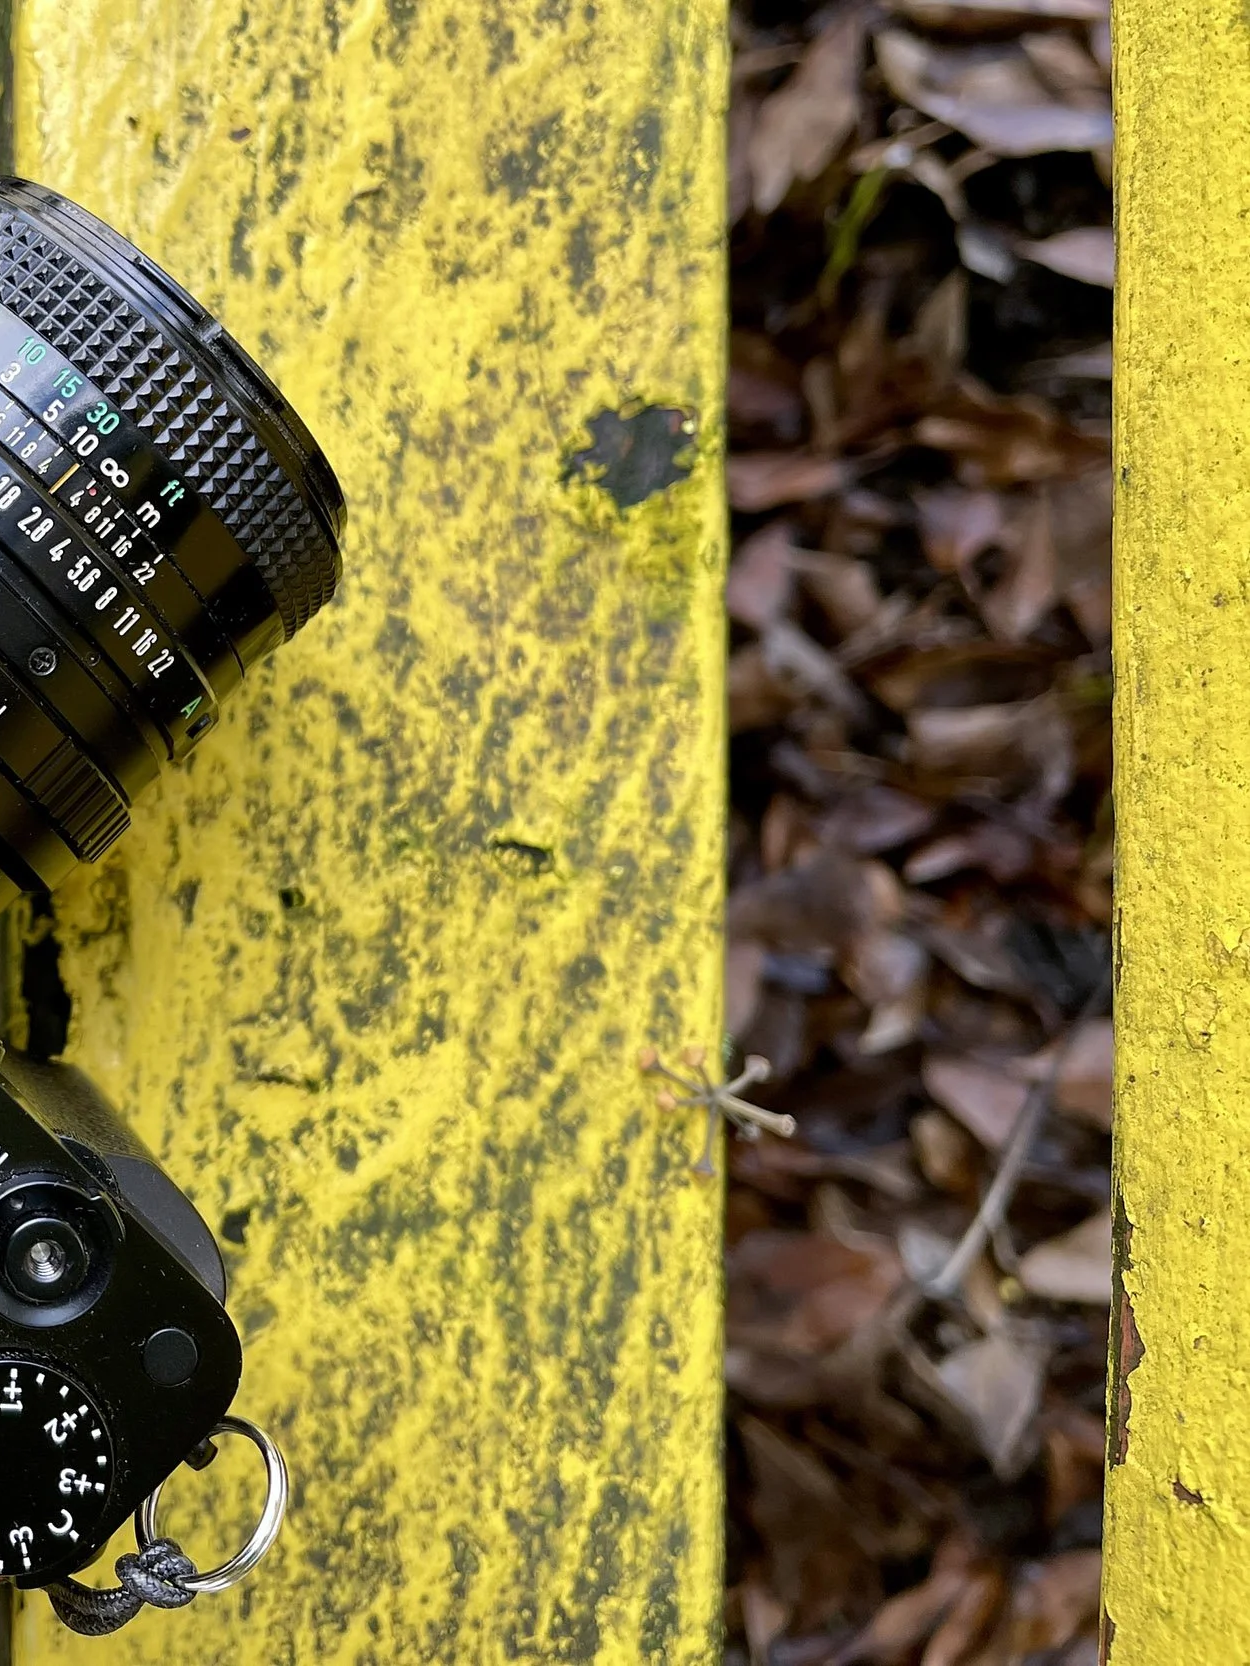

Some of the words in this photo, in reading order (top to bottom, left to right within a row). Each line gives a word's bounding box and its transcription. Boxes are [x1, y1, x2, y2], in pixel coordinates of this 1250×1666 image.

[0, 362, 22, 383] 3
[42, 400, 65, 423] 5
[69, 425, 99, 457] 10
[136, 501, 161, 528] m
[17, 335, 47, 366] 10
[52, 367, 83, 398] 15
[86, 401, 121, 435] 30
[159, 479, 185, 508] ft
[5, 426, 26, 448] 11
[20, 441, 38, 459] 8
[37, 457, 53, 475] 4
[69, 490, 85, 507] 4
[84, 506, 102, 524] 8
[94, 517, 116, 539] 11
[111, 535, 133, 558] 16
[133, 561, 156, 586] 22
[17, 506, 54, 542] 2.8
[49, 538, 72, 562] 4
[67, 555, 101, 592] 5.6
[94, 587, 118, 610] 8
[113, 606, 141, 636] 11
[131, 628, 158, 656] 16
[147, 648, 175, 679] 22
[180, 696, 202, 720] A
[0, 1381, 24, 1411] +1
[44, 1412, 78, 1444] +2
[48, 1509, 73, 1534] C
[58, 1468, 92, 1495] +3
